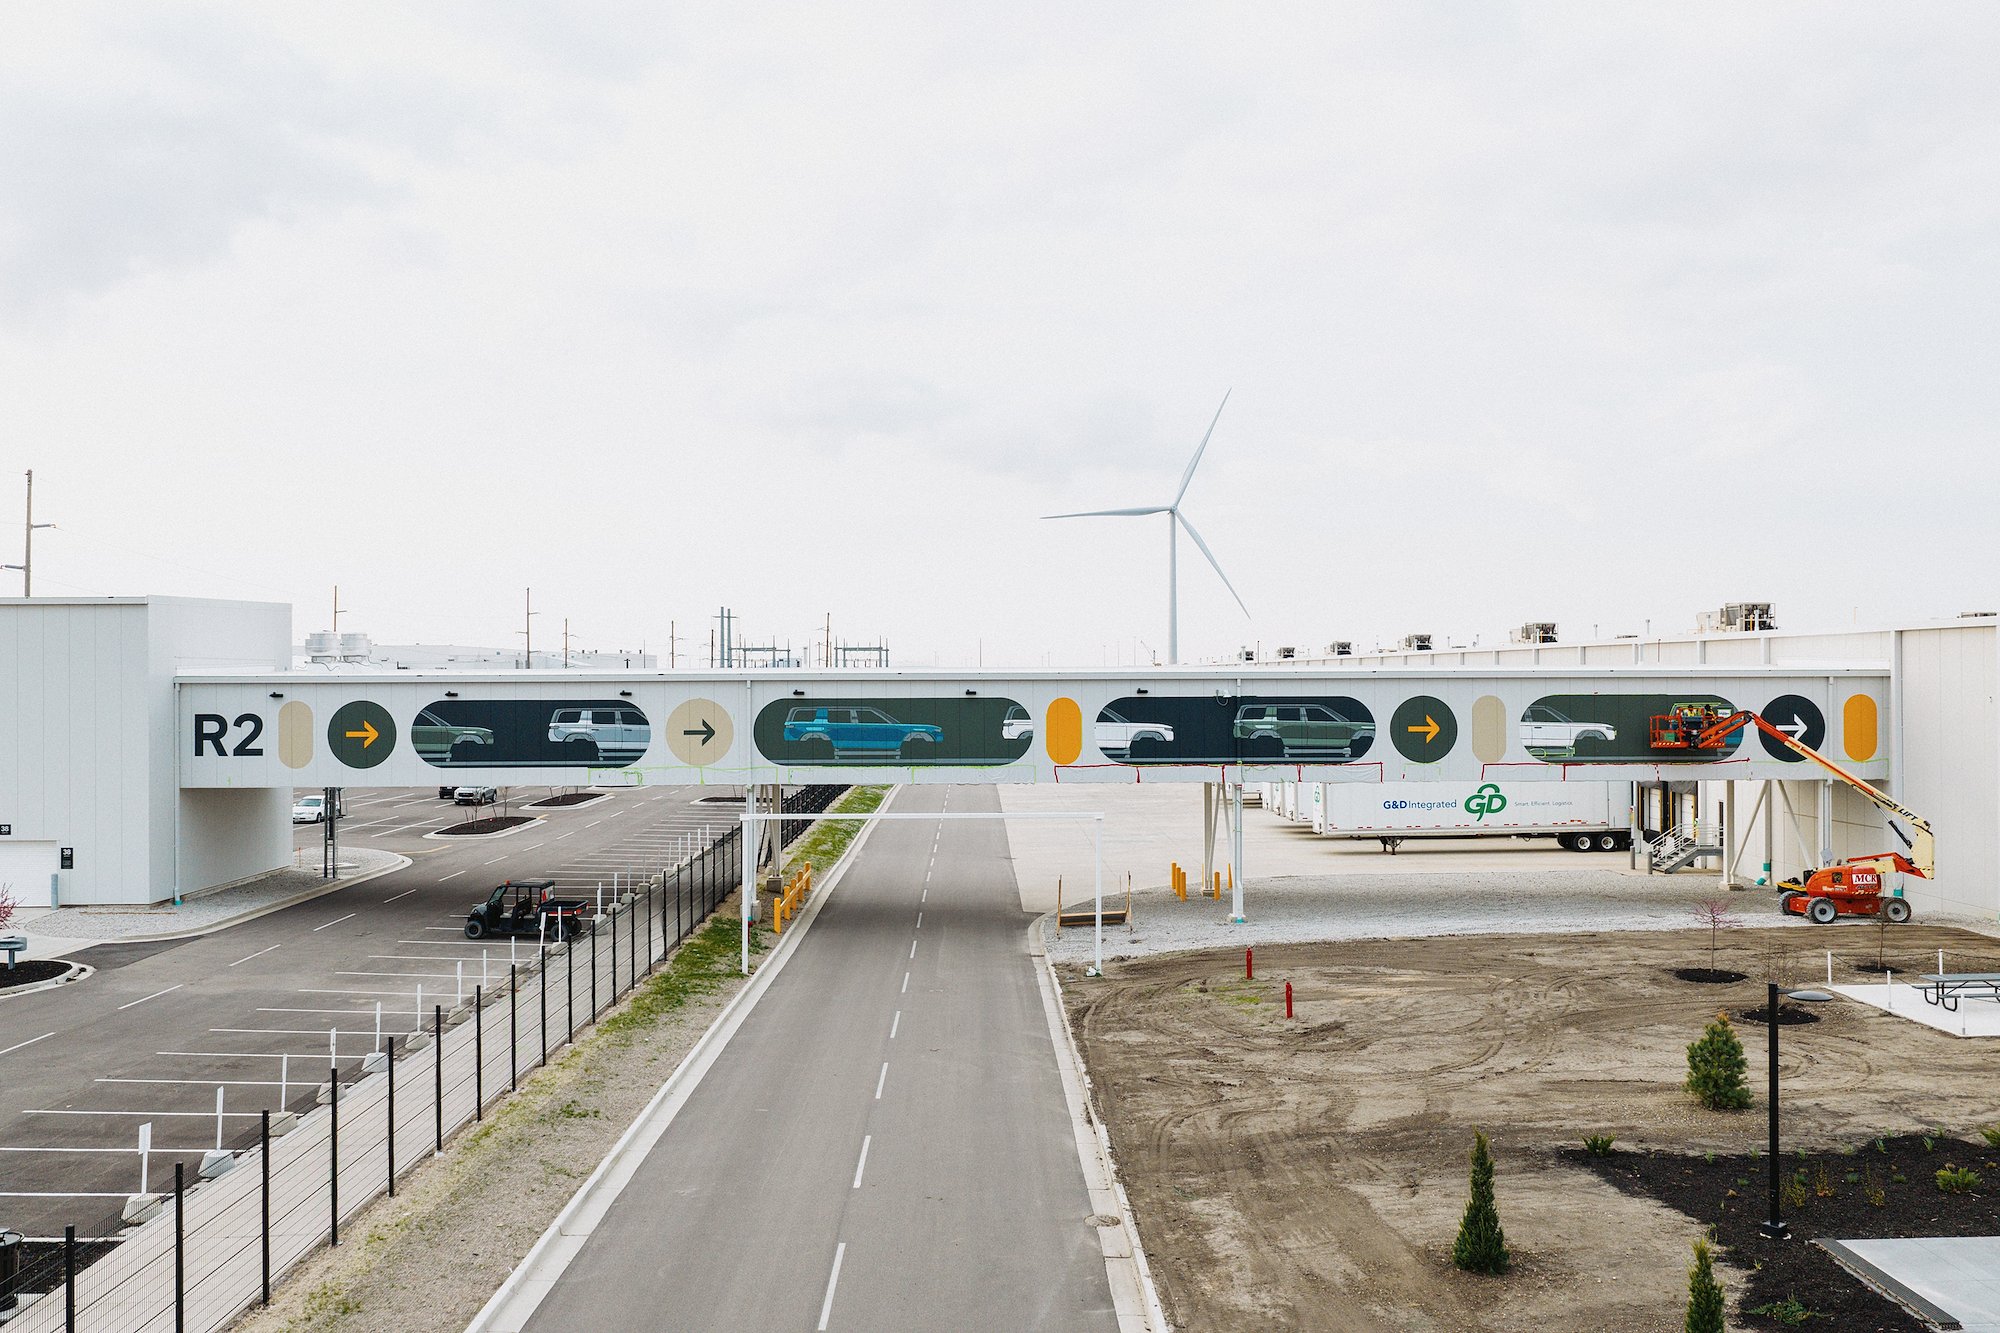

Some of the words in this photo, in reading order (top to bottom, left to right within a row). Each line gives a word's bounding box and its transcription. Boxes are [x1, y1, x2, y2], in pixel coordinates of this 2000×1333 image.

[194, 713, 264, 757] R2
[1383, 800, 1408, 810] G&D
[1408, 800, 1457, 810] Integrated
[1898, 808, 1919, 820] LIFT
[1854, 874, 1877, 883] MCR
